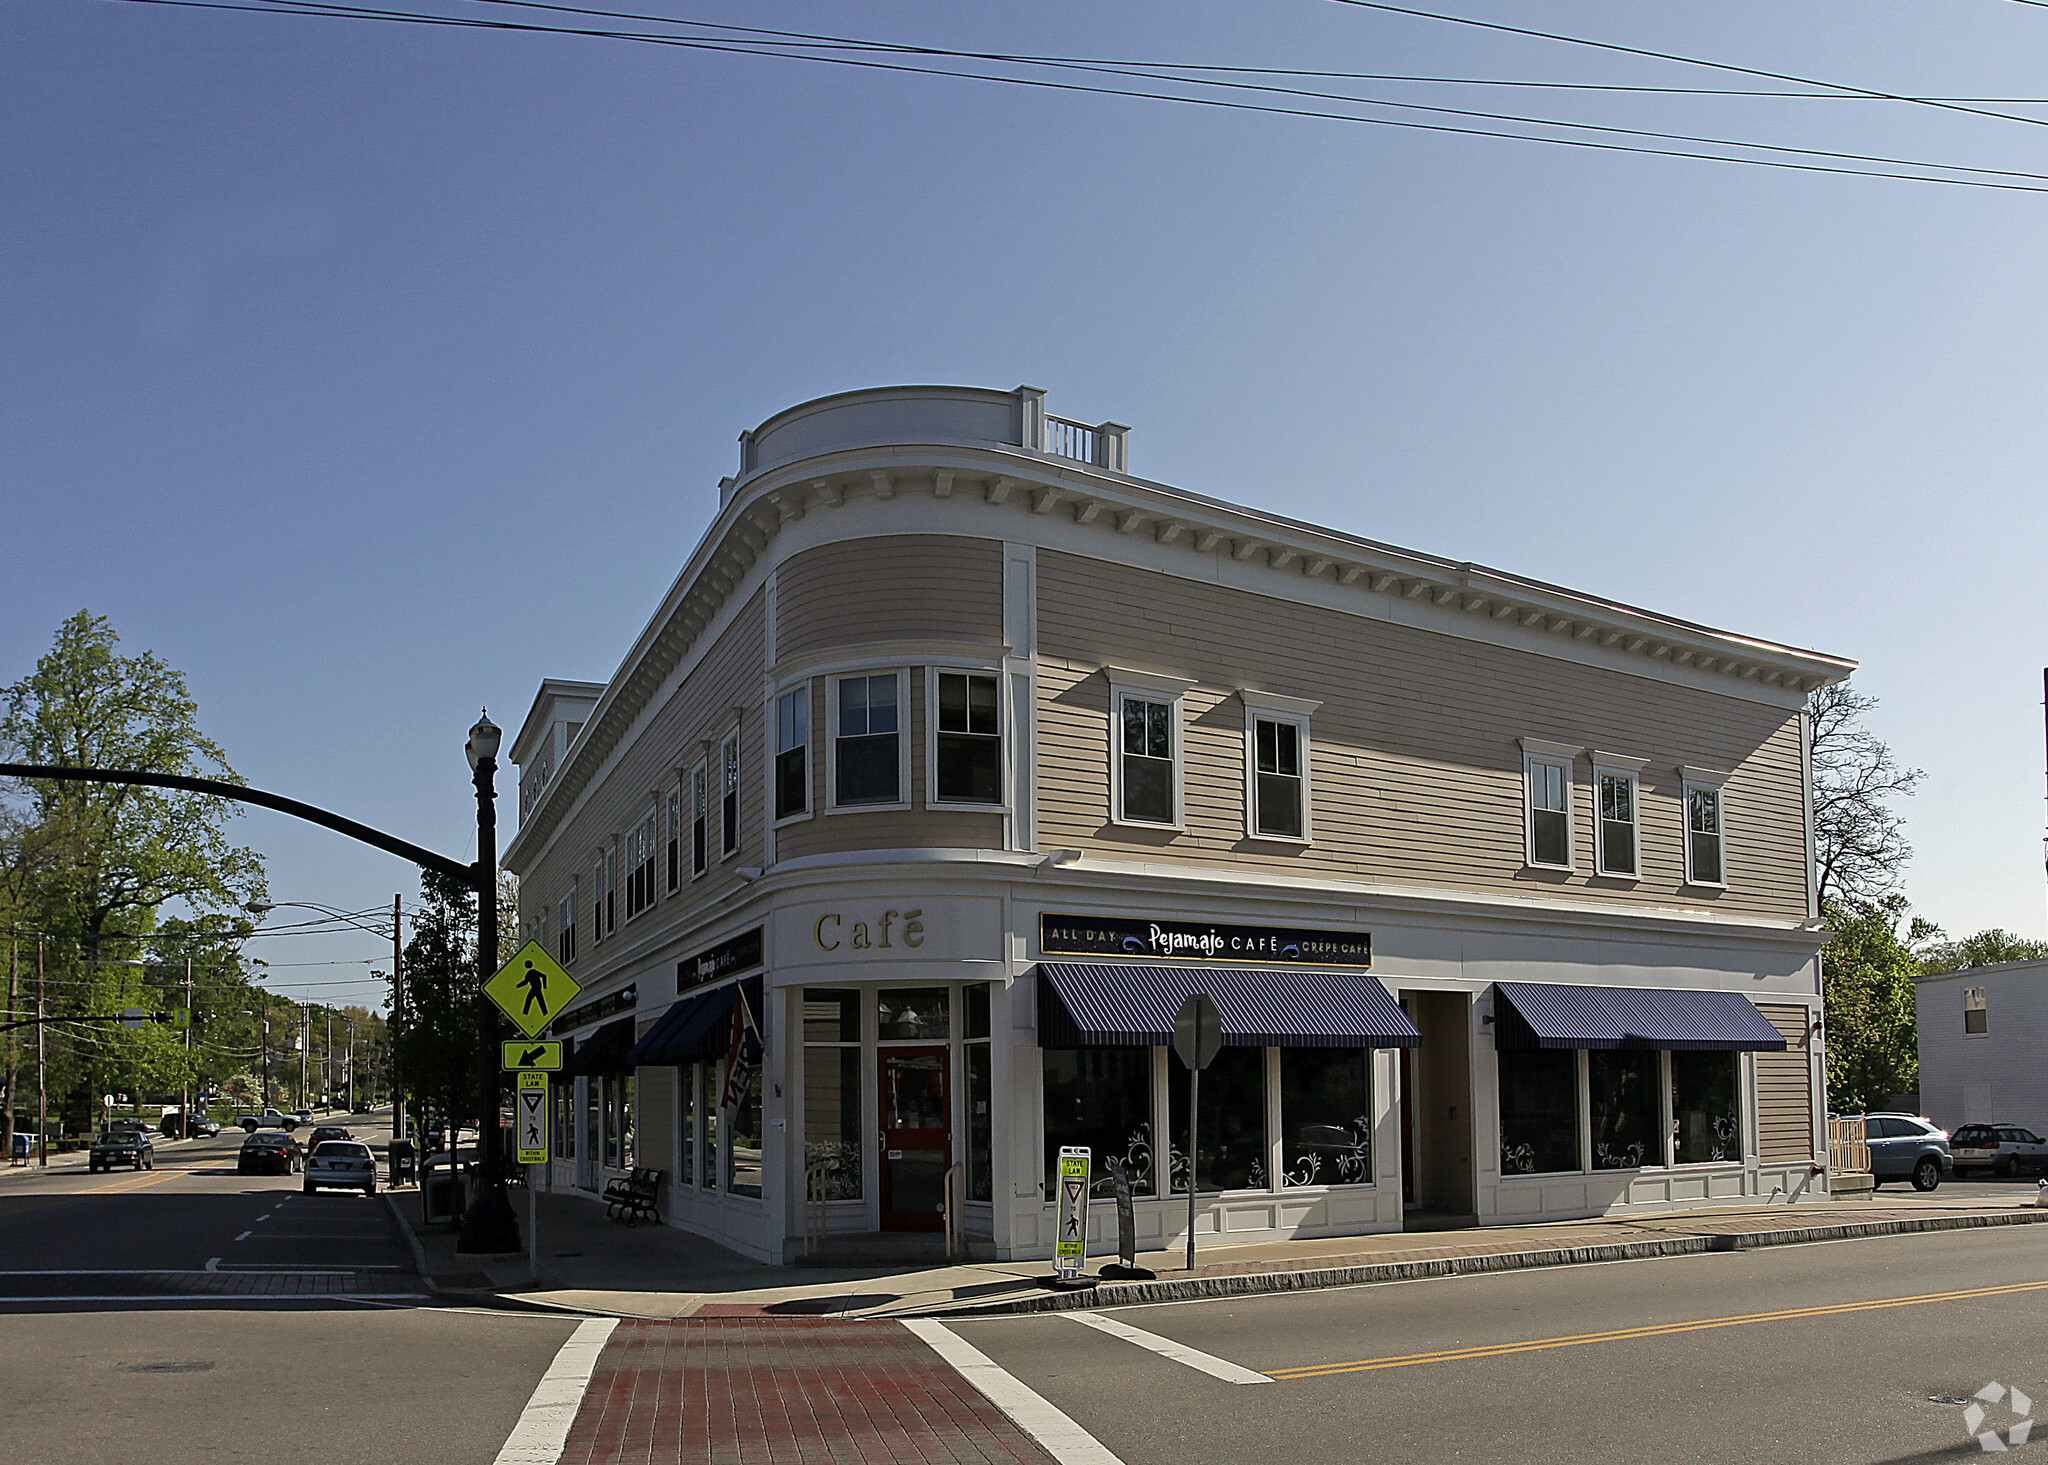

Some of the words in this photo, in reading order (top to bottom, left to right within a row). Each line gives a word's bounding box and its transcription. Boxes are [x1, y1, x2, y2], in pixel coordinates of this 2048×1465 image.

[813, 909, 925, 951] Café
[1051, 927, 1078, 940] ALL
[1086, 929, 1116, 942] DAY
[1147, 923, 1224, 956] Pejamajo
[1231, 936, 1278, 952] CAFÉ
